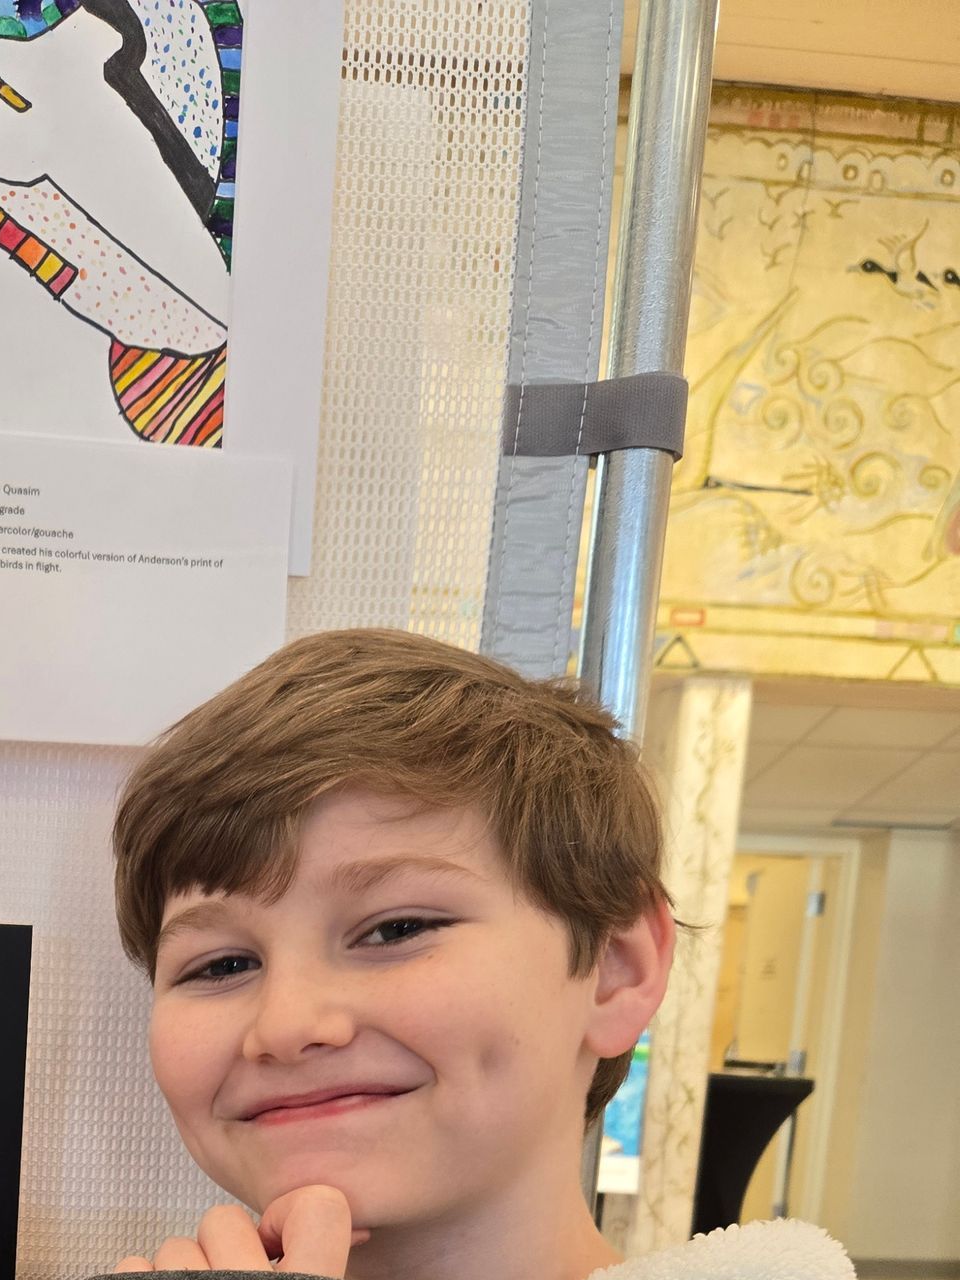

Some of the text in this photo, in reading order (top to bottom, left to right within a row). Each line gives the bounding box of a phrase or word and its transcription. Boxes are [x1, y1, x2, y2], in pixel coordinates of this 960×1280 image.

[3, 484, 41, 497] Quasim
[0, 506, 25, 516] grade
[1, 546, 37, 557] created
[38, 547, 53, 558] his
[54, 549, 90, 561] colorful
[91, 553, 125, 562] version
[127, 554, 137, 564] of
[138, 555, 189, 567] Anderson's
[190, 559, 212, 569] print
[213, 559, 224, 569] of
[0, 560, 23, 571] birds
[25, 562, 34, 571] in
